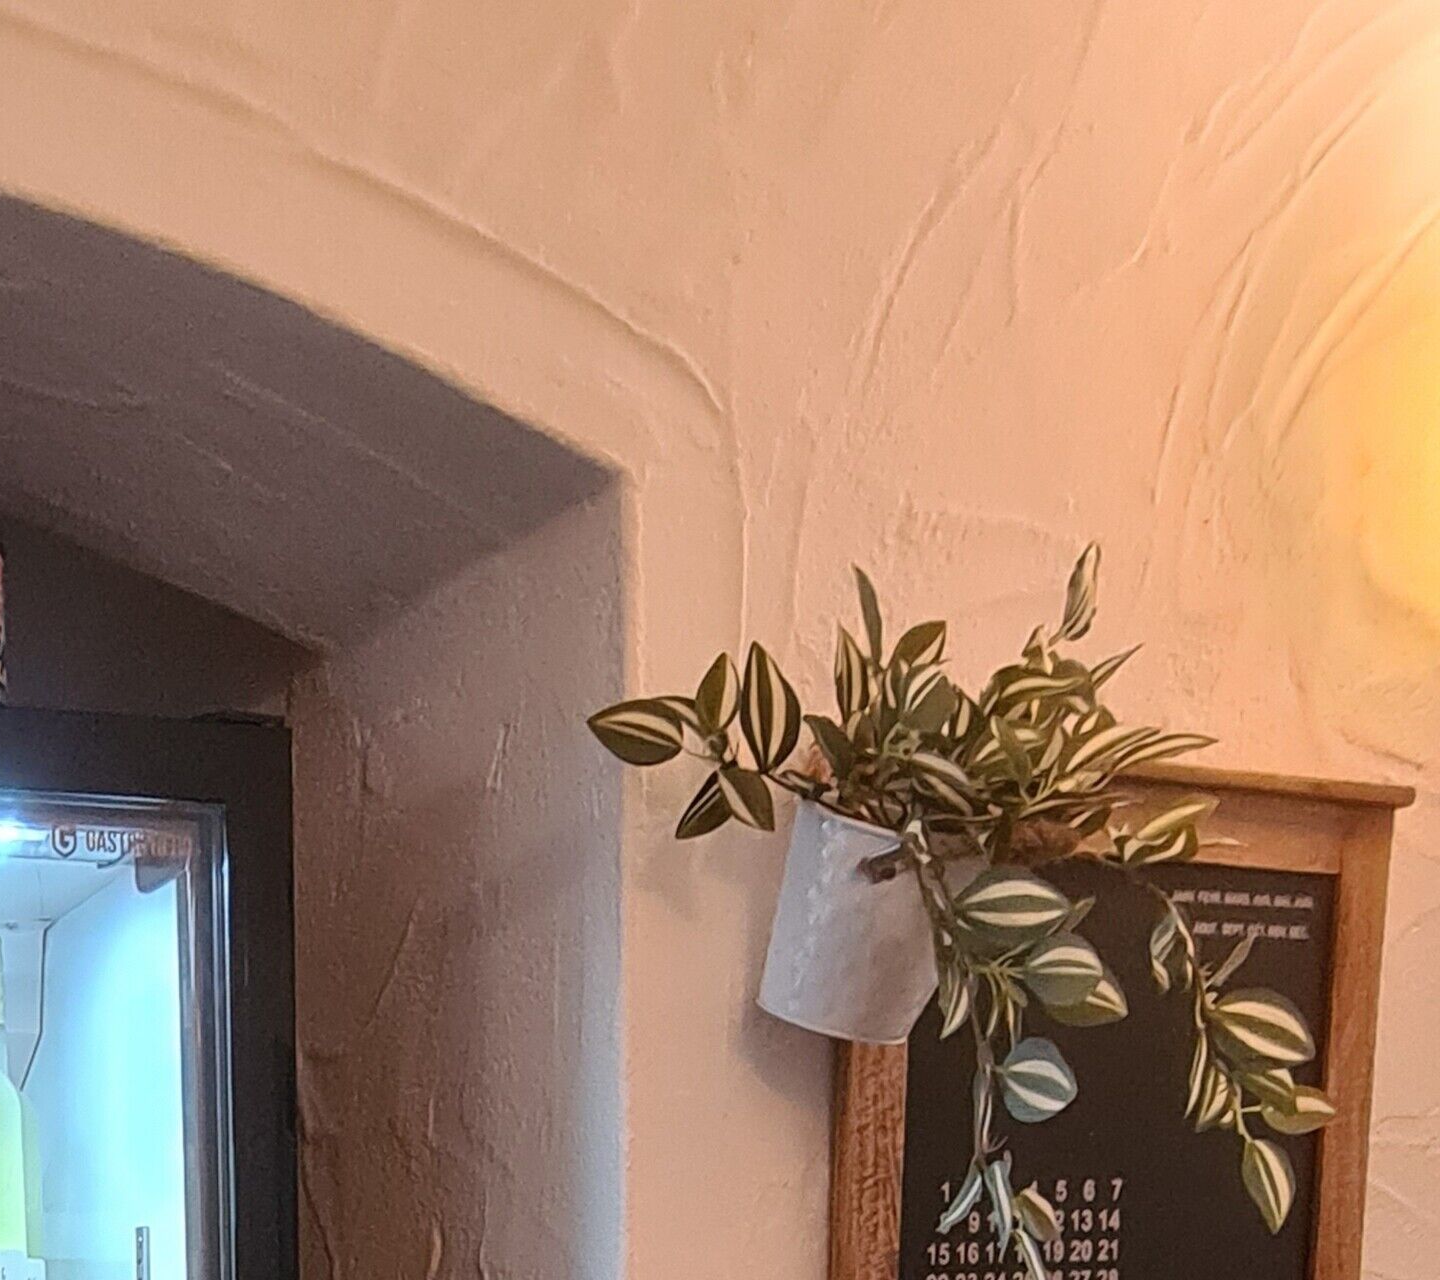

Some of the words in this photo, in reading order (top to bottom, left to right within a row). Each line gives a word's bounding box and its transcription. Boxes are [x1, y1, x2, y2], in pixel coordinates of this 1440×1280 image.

[940, 1181, 950, 1203] 1
[1055, 1179, 1068, 1202] 5
[1083, 1178, 1096, 1202] 6
[1111, 1177, 1123, 1201] 7
[968, 1211, 980, 1234] 9
[1071, 1209, 1093, 1233] 13
[1098, 1208, 1120, 1232] 14
[927, 1242, 951, 1266] 15
[956, 1241, 979, 1265] 16
[1043, 1240, 1065, 1263] 19
[1068, 1239, 1093, 1262] 20
[1097, 1239, 1119, 1262] 21
